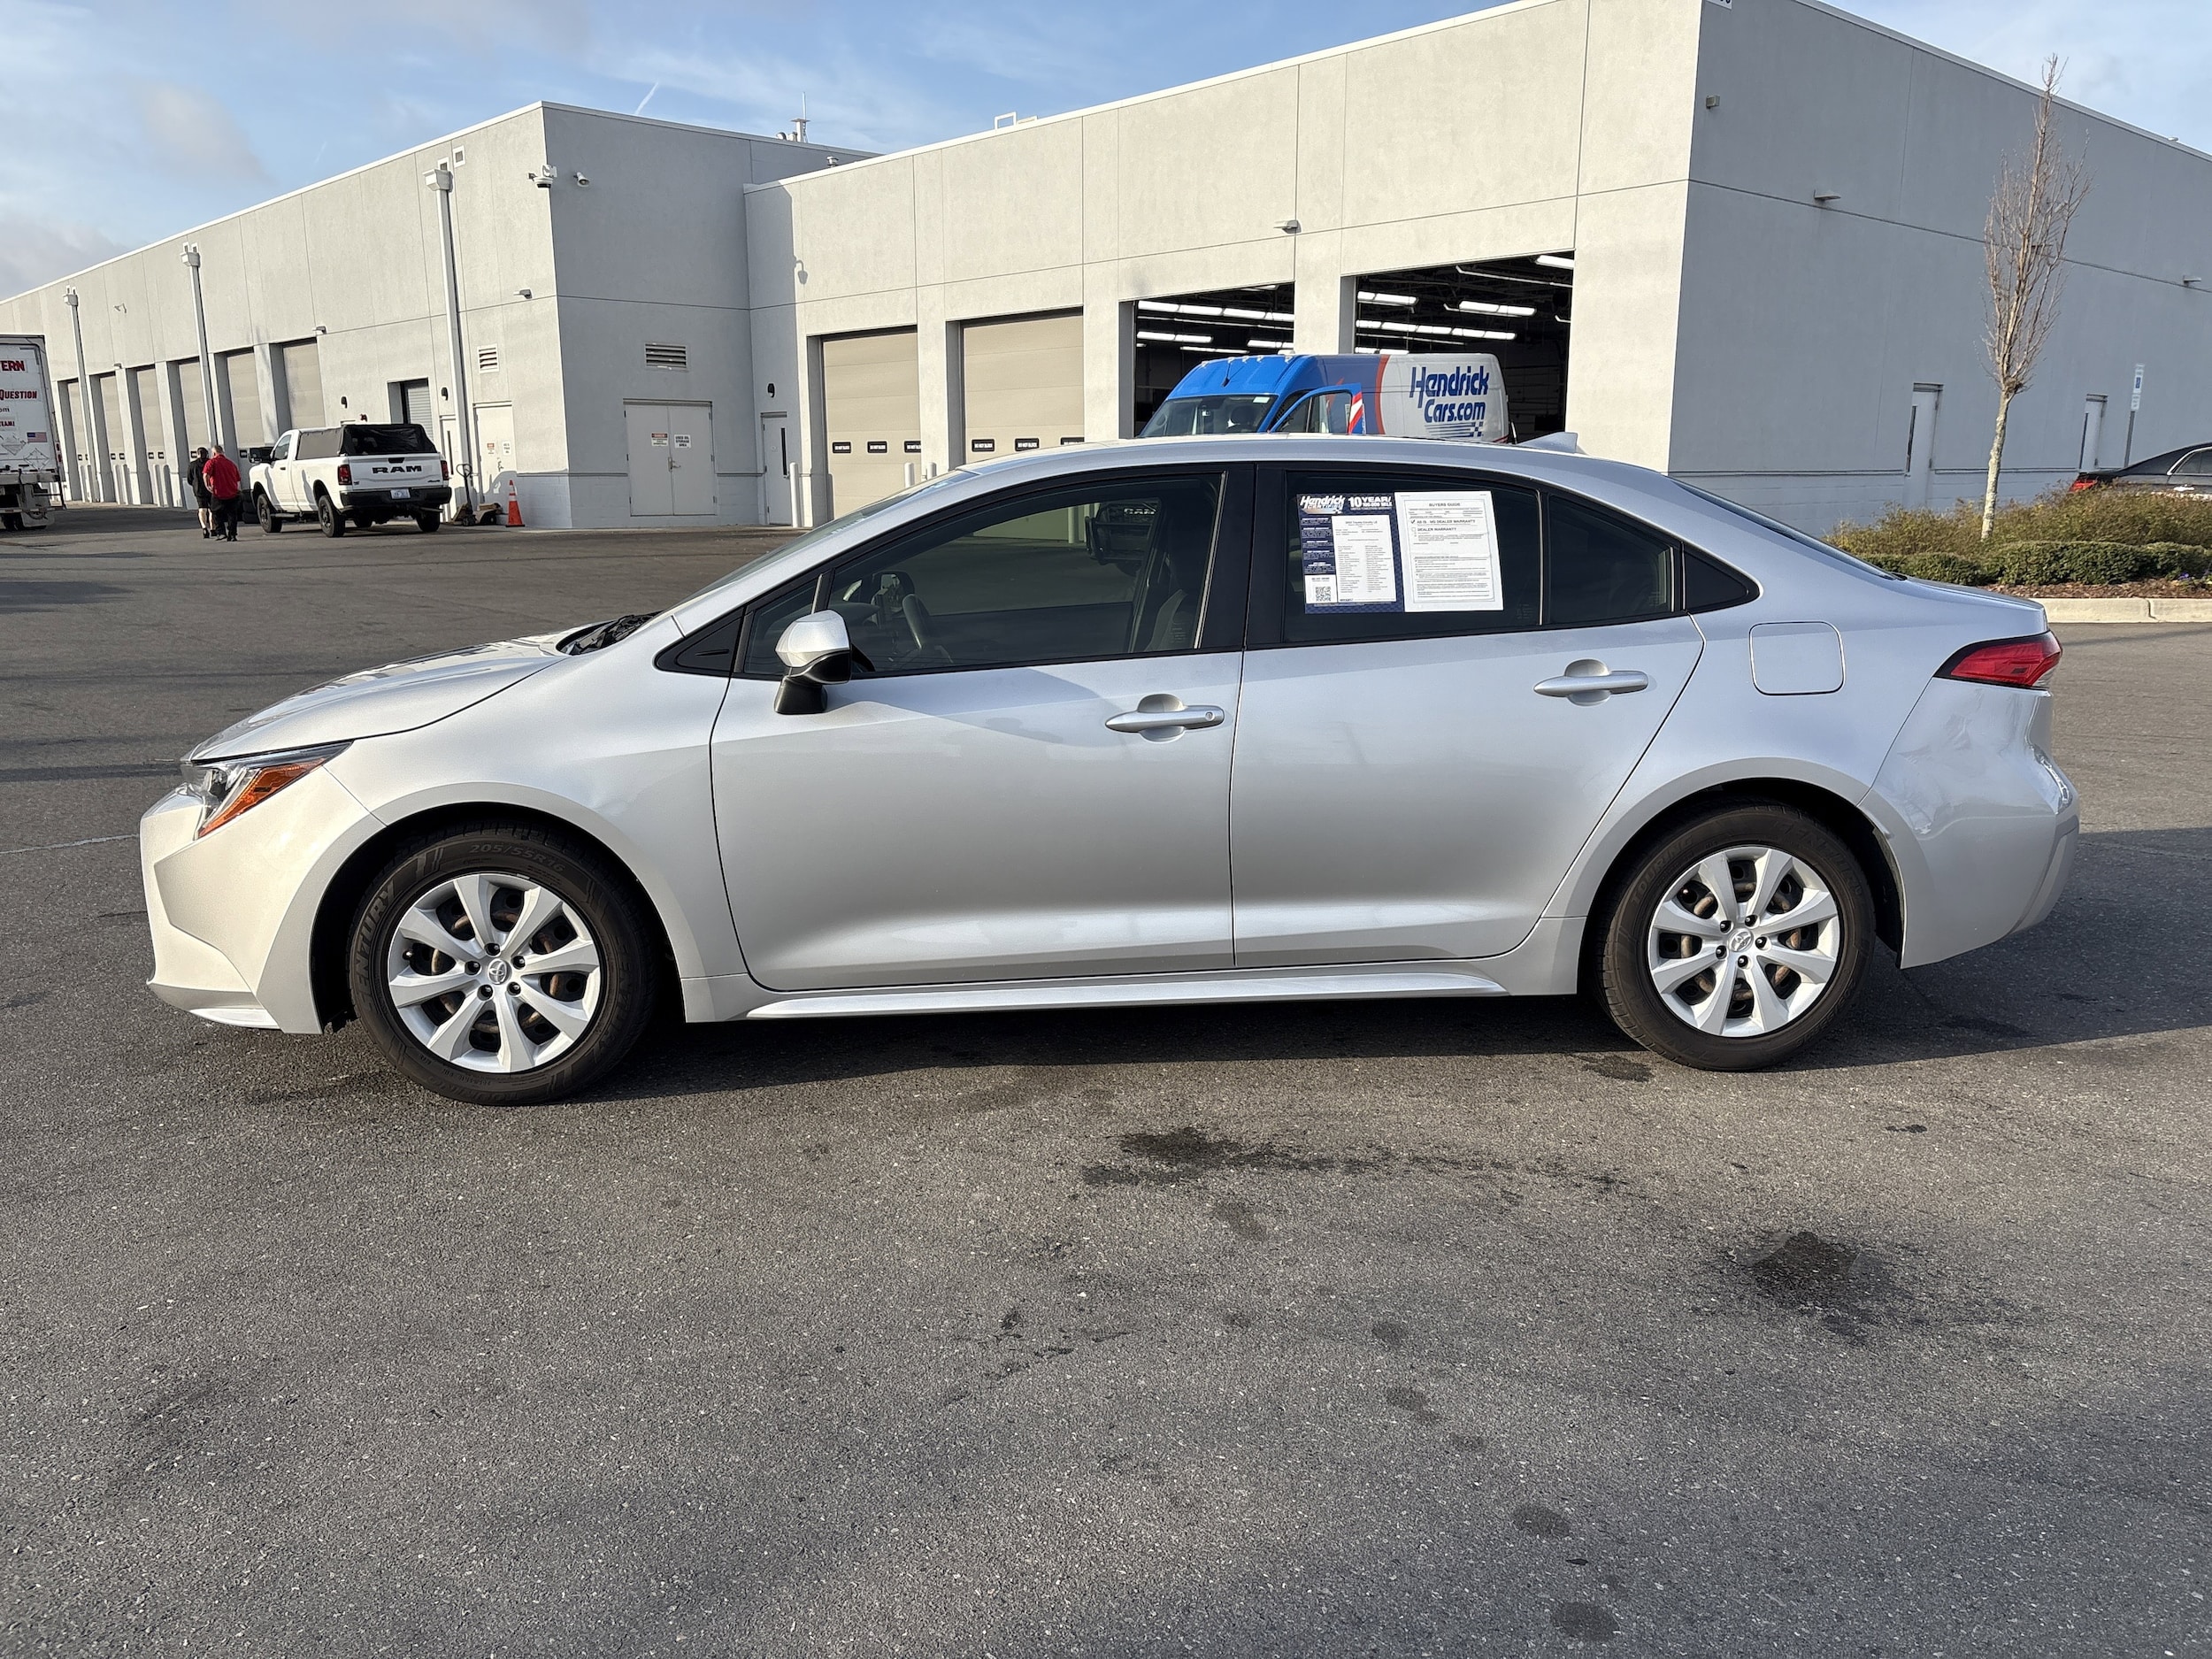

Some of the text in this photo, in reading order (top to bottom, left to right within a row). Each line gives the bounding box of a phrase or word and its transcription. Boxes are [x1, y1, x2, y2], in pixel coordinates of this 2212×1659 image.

[0, 360, 25, 371] ERN
[1409, 365, 1489, 408] Hendrick
[1424, 398, 1486, 423] Cars.com
[1300, 495, 1345, 509] Hendrick
[1348, 496, 1363, 508] 10
[469, 843, 566, 873] 205/55R16
[1632, 835, 1694, 905] TOURING
